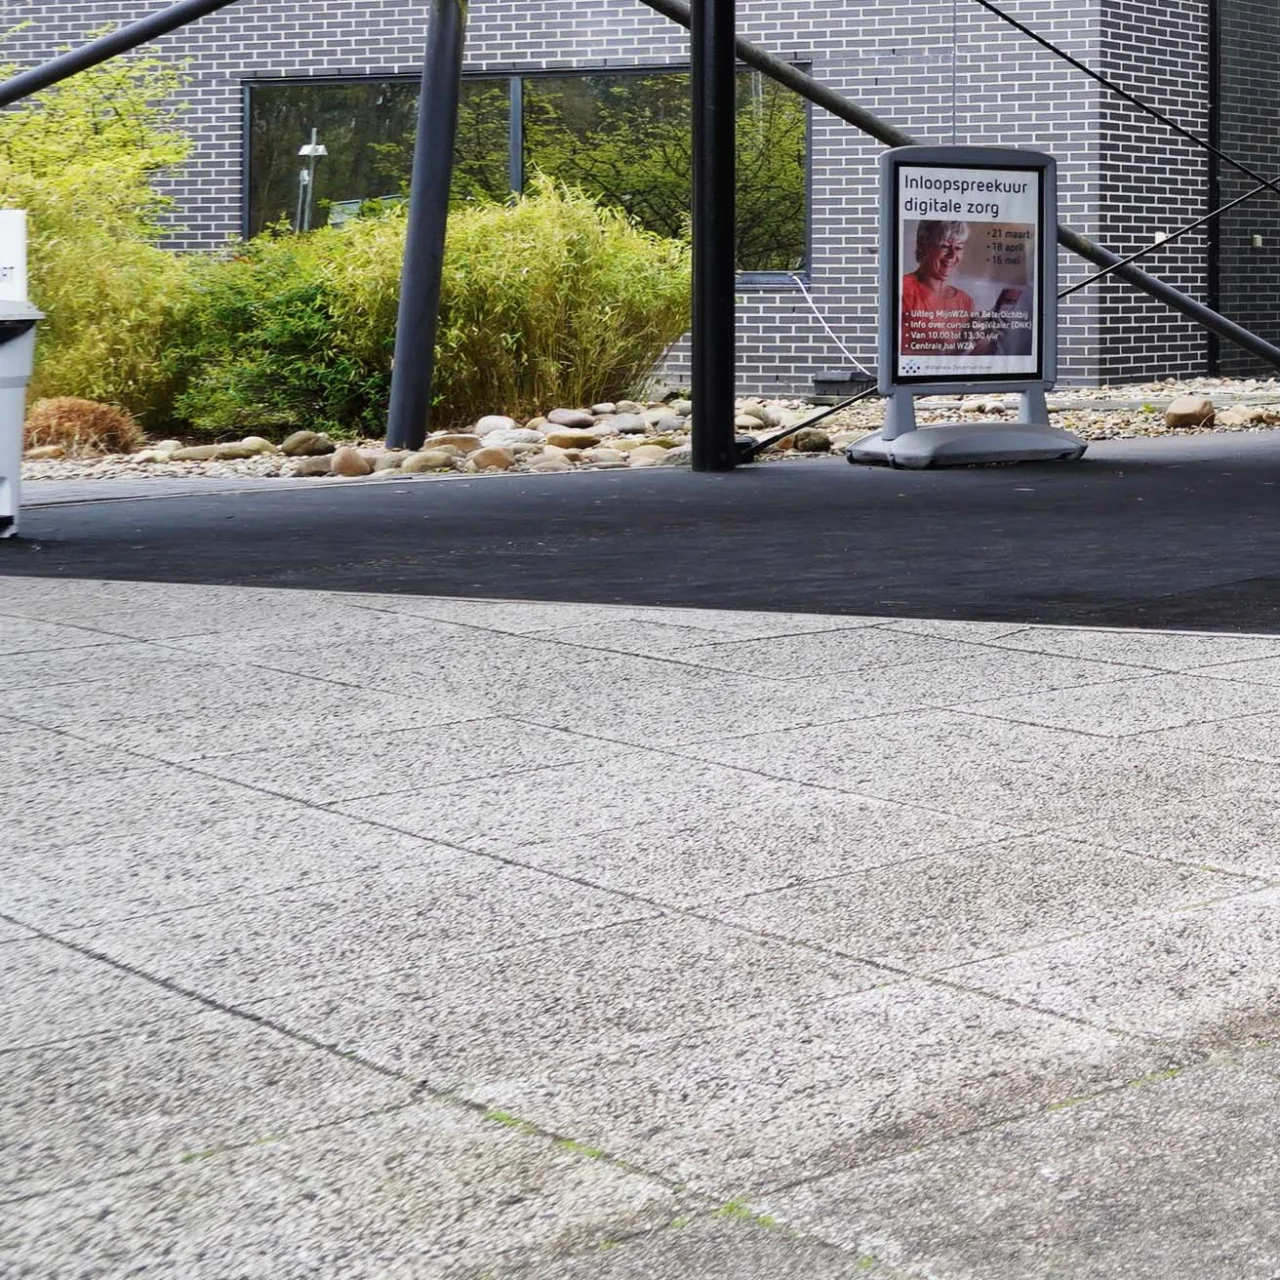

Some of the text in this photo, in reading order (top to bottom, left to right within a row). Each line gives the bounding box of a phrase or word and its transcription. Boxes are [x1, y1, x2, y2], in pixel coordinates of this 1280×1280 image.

[904, 174, 1028, 195] Inloopspreekuur
[904, 197, 999, 218] digitale zorg
[992, 228, 1030, 239] 21 maart
[910, 310, 934, 320] Uitleg
[910, 320, 927, 329] Info
[910, 331, 926, 339] Van
[928, 331, 950, 339] 10.00
